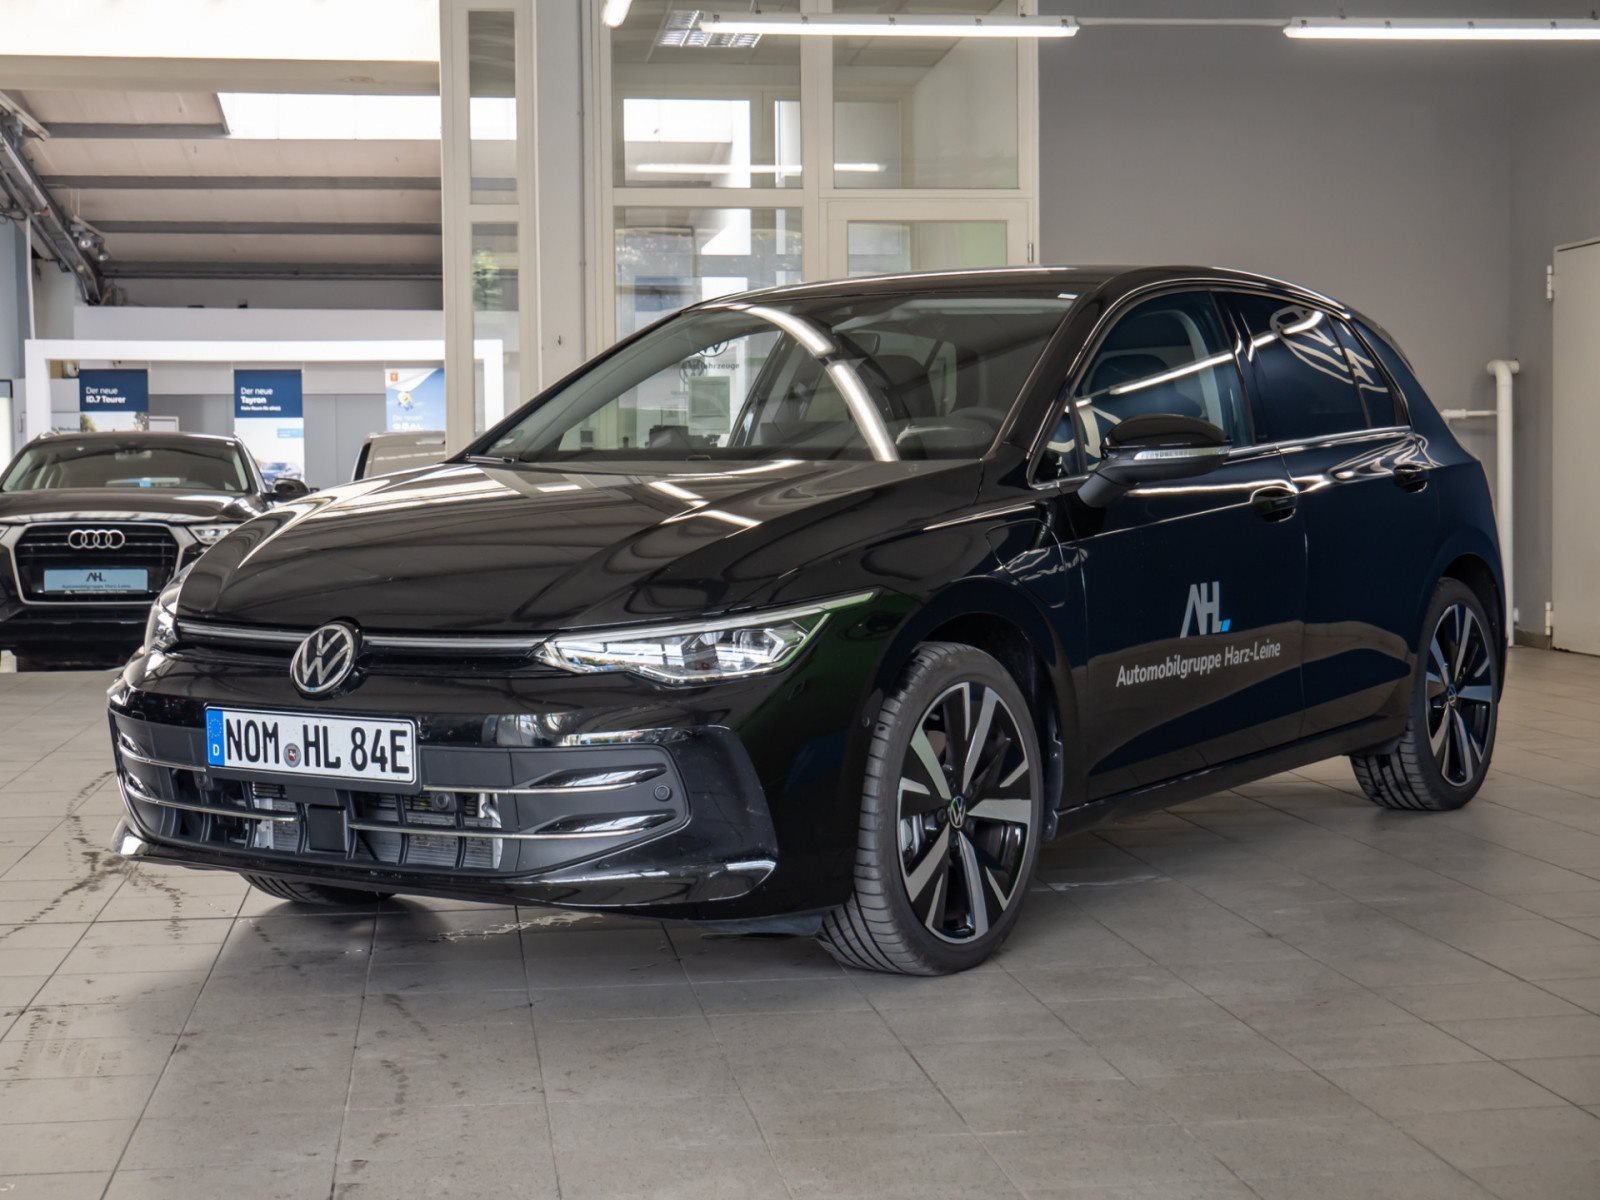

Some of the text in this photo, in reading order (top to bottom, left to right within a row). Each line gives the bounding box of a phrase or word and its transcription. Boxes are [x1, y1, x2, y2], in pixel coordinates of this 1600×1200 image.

[241, 387, 253, 395] Der
[241, 396, 267, 405] Tayron
[1116, 639, 1281, 687] Automobilgruppe Harz-Leine
[213, 744, 220, 756] D
[225, 718, 411, 774] NOM HL 84E
